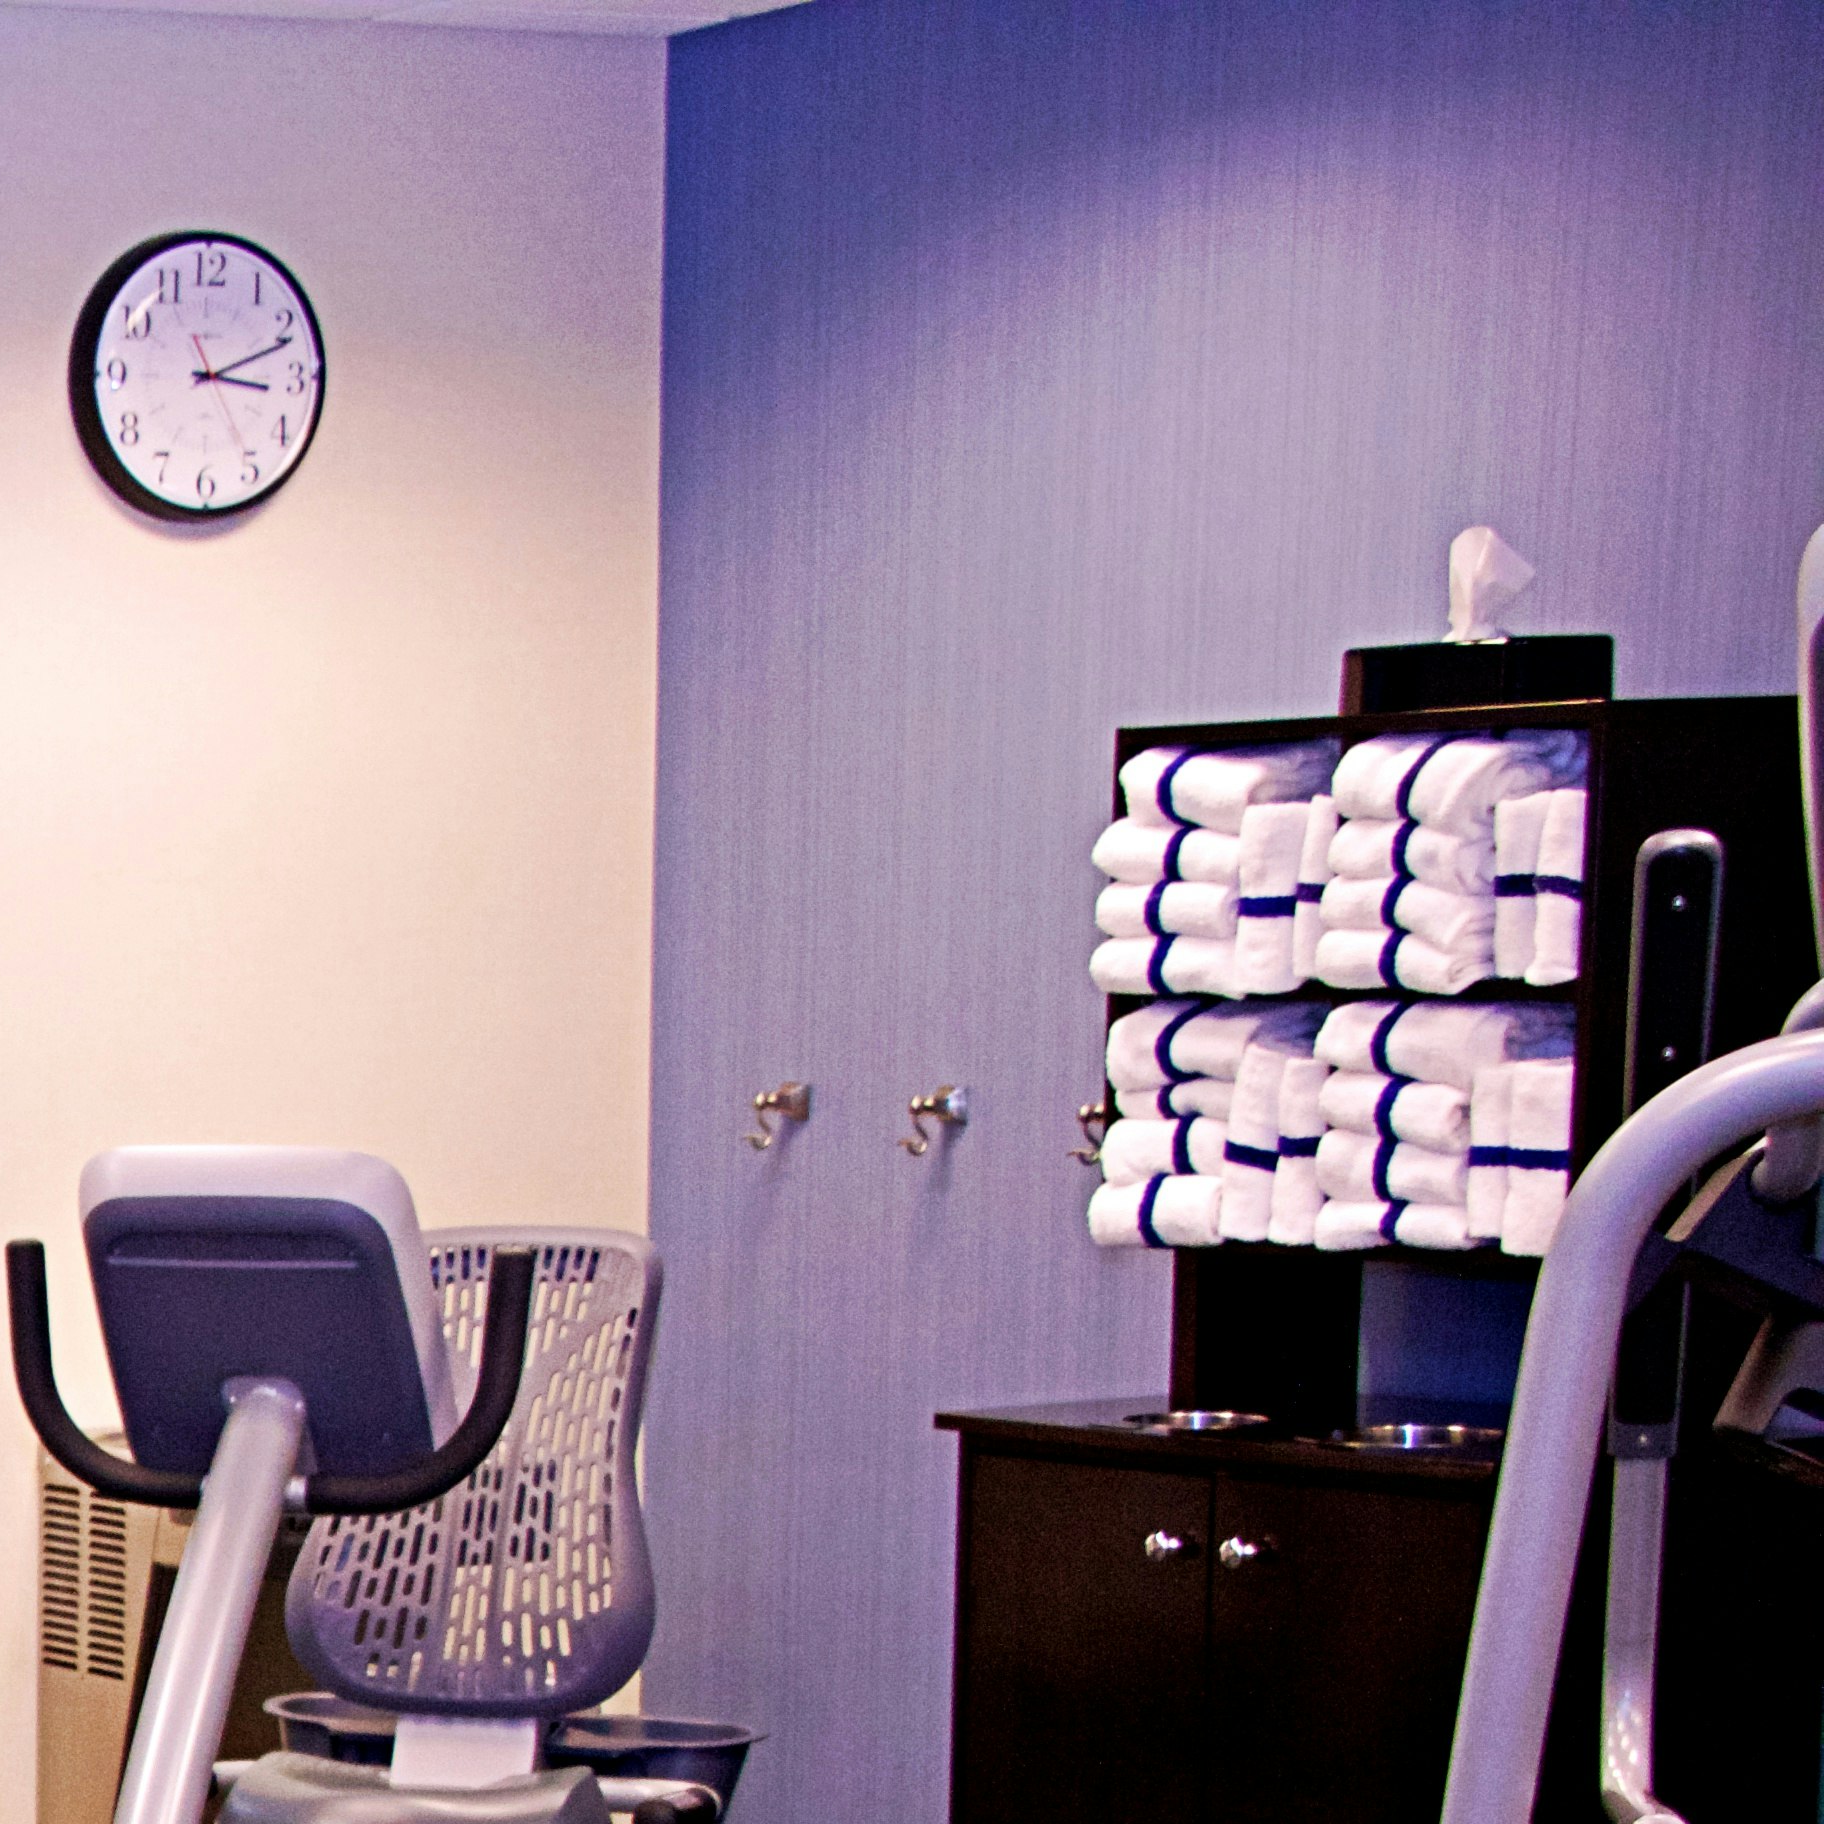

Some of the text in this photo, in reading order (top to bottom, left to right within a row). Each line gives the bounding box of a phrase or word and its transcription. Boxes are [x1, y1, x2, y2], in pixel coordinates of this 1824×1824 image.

[157, 268, 180, 304] 11
[193, 251, 227, 287] 12
[252, 270, 262, 306] 1
[122, 304, 152, 340] 10
[274, 308, 295, 345] 2
[107, 357, 128, 392] 9
[285, 360, 306, 396] 3
[119, 411, 140, 446] 8
[270, 413, 290, 448] 4
[152, 450, 171, 484] 7
[195, 467, 217, 499] 6
[240, 450, 260, 485] 5
